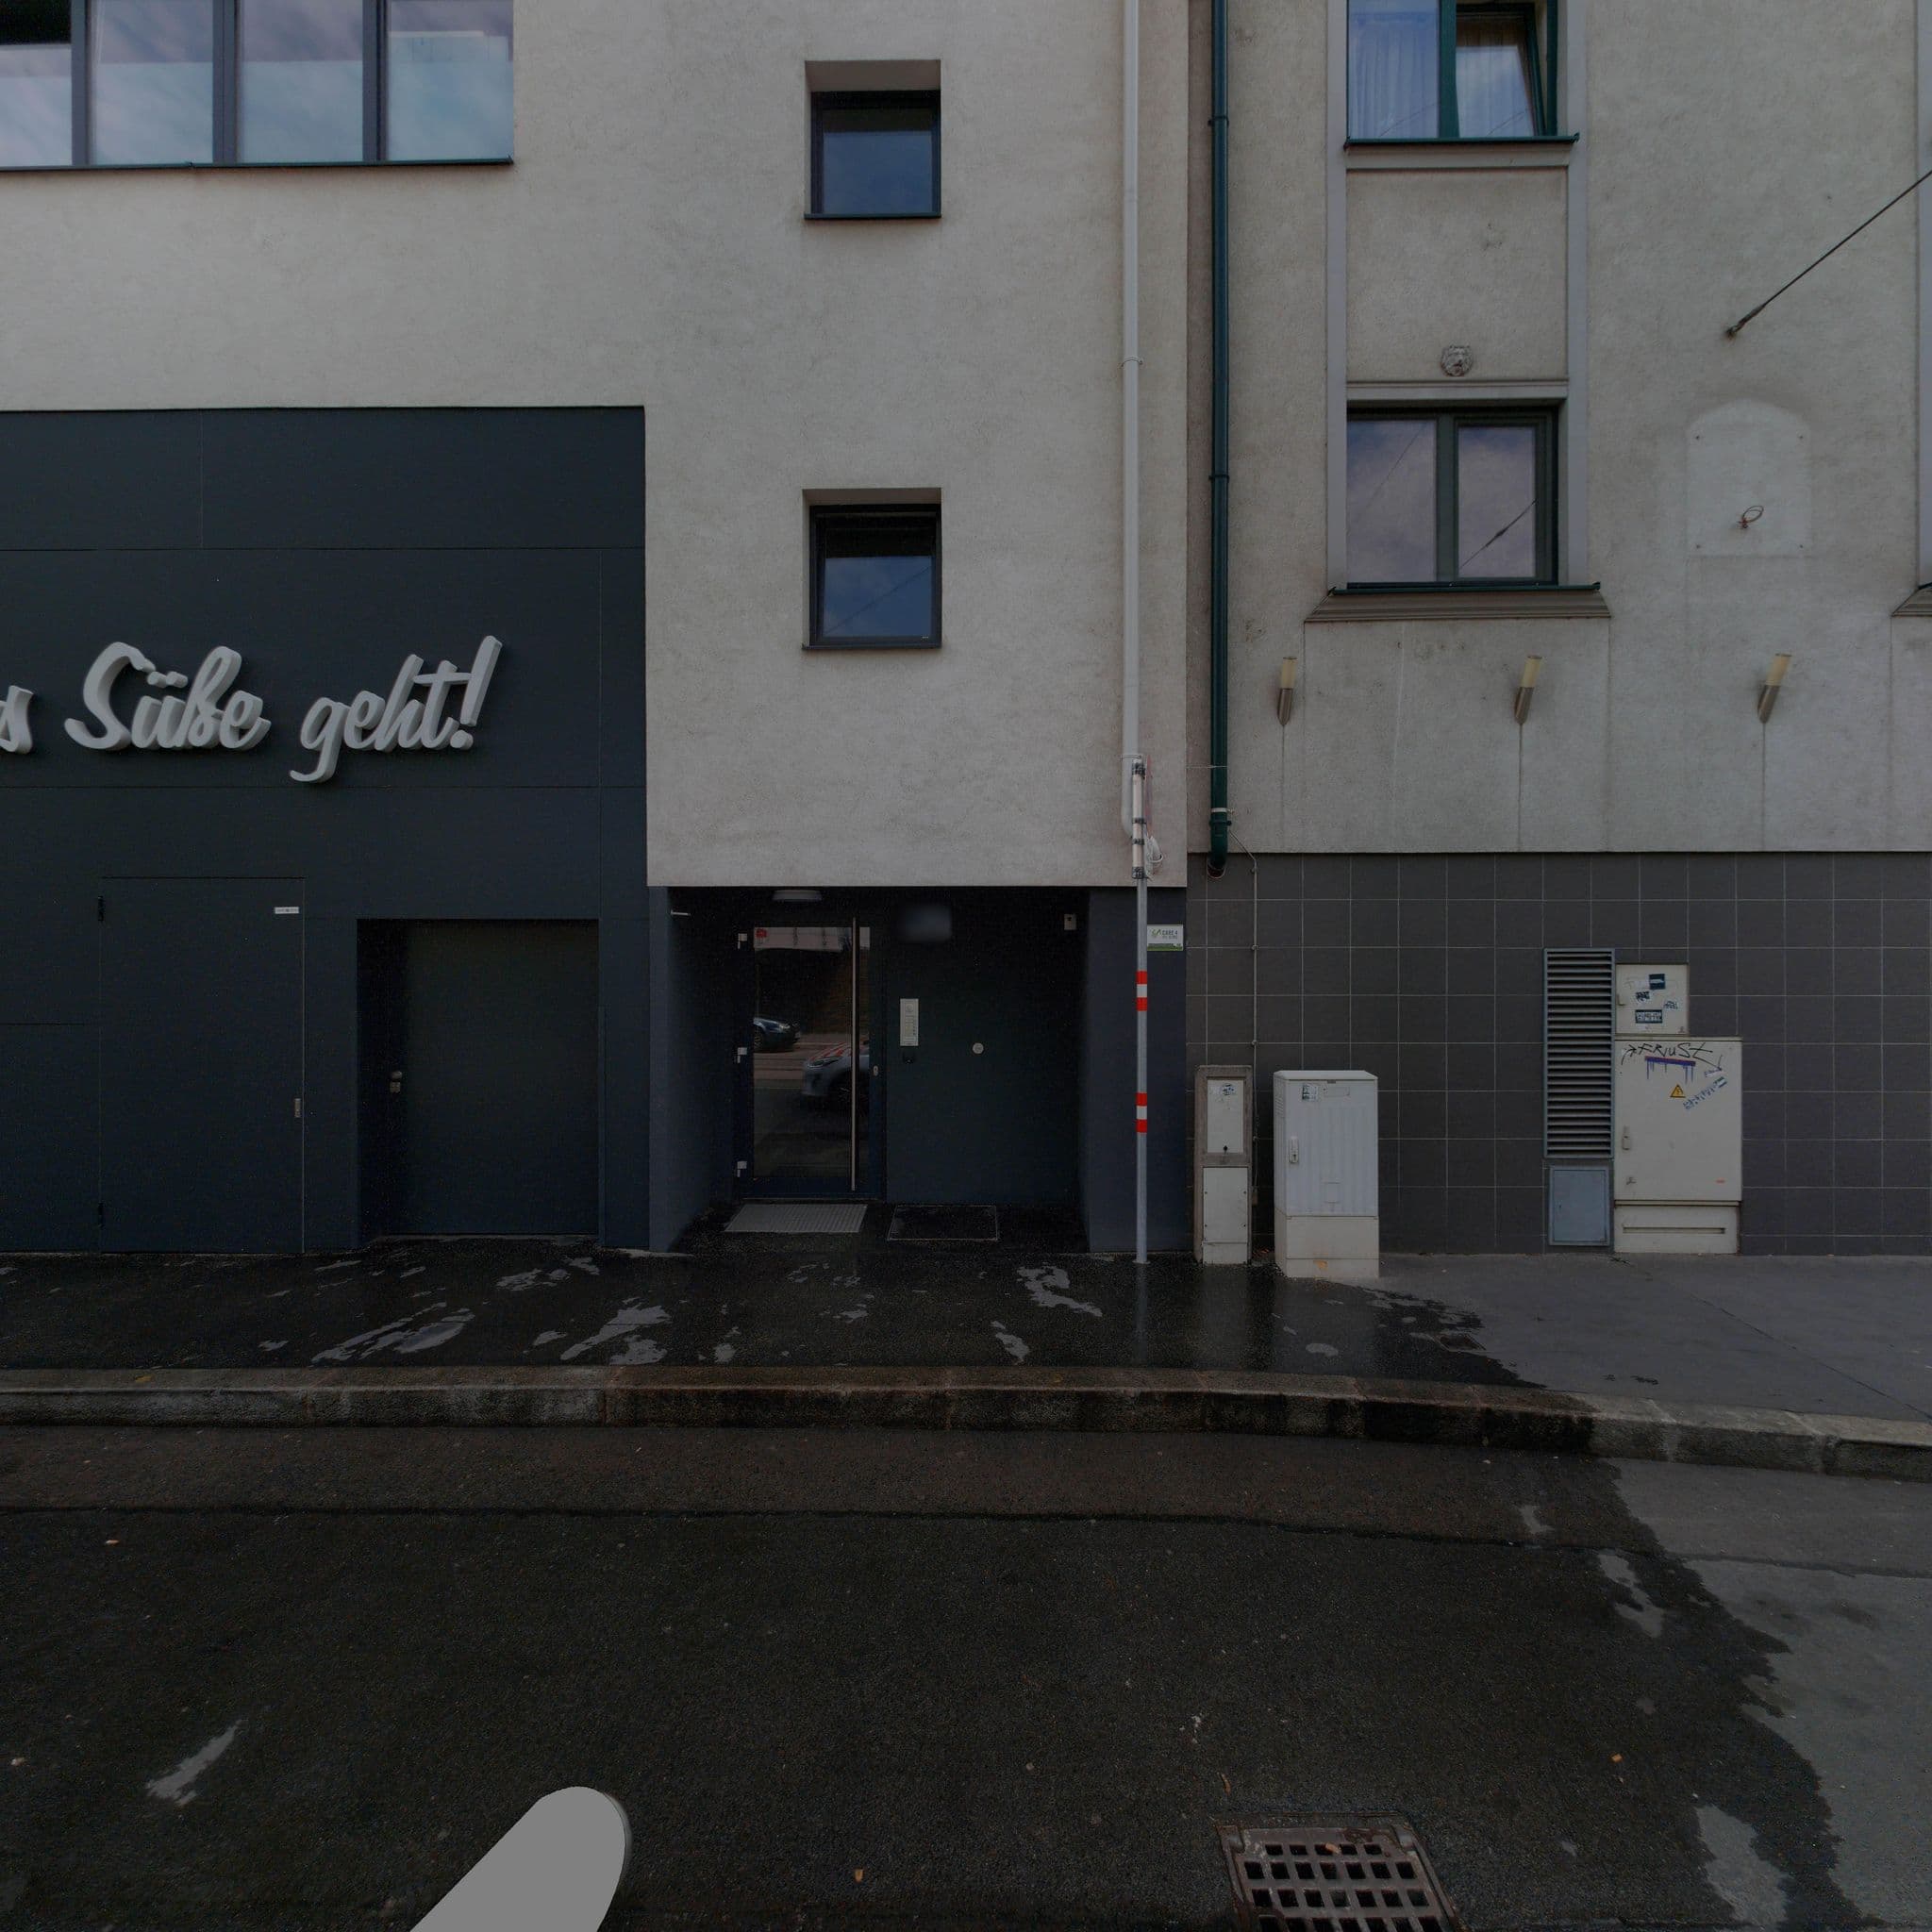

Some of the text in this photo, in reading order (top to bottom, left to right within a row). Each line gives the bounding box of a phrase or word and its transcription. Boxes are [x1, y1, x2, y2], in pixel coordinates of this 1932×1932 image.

[0, 635, 503, 783] s Süße geht!
